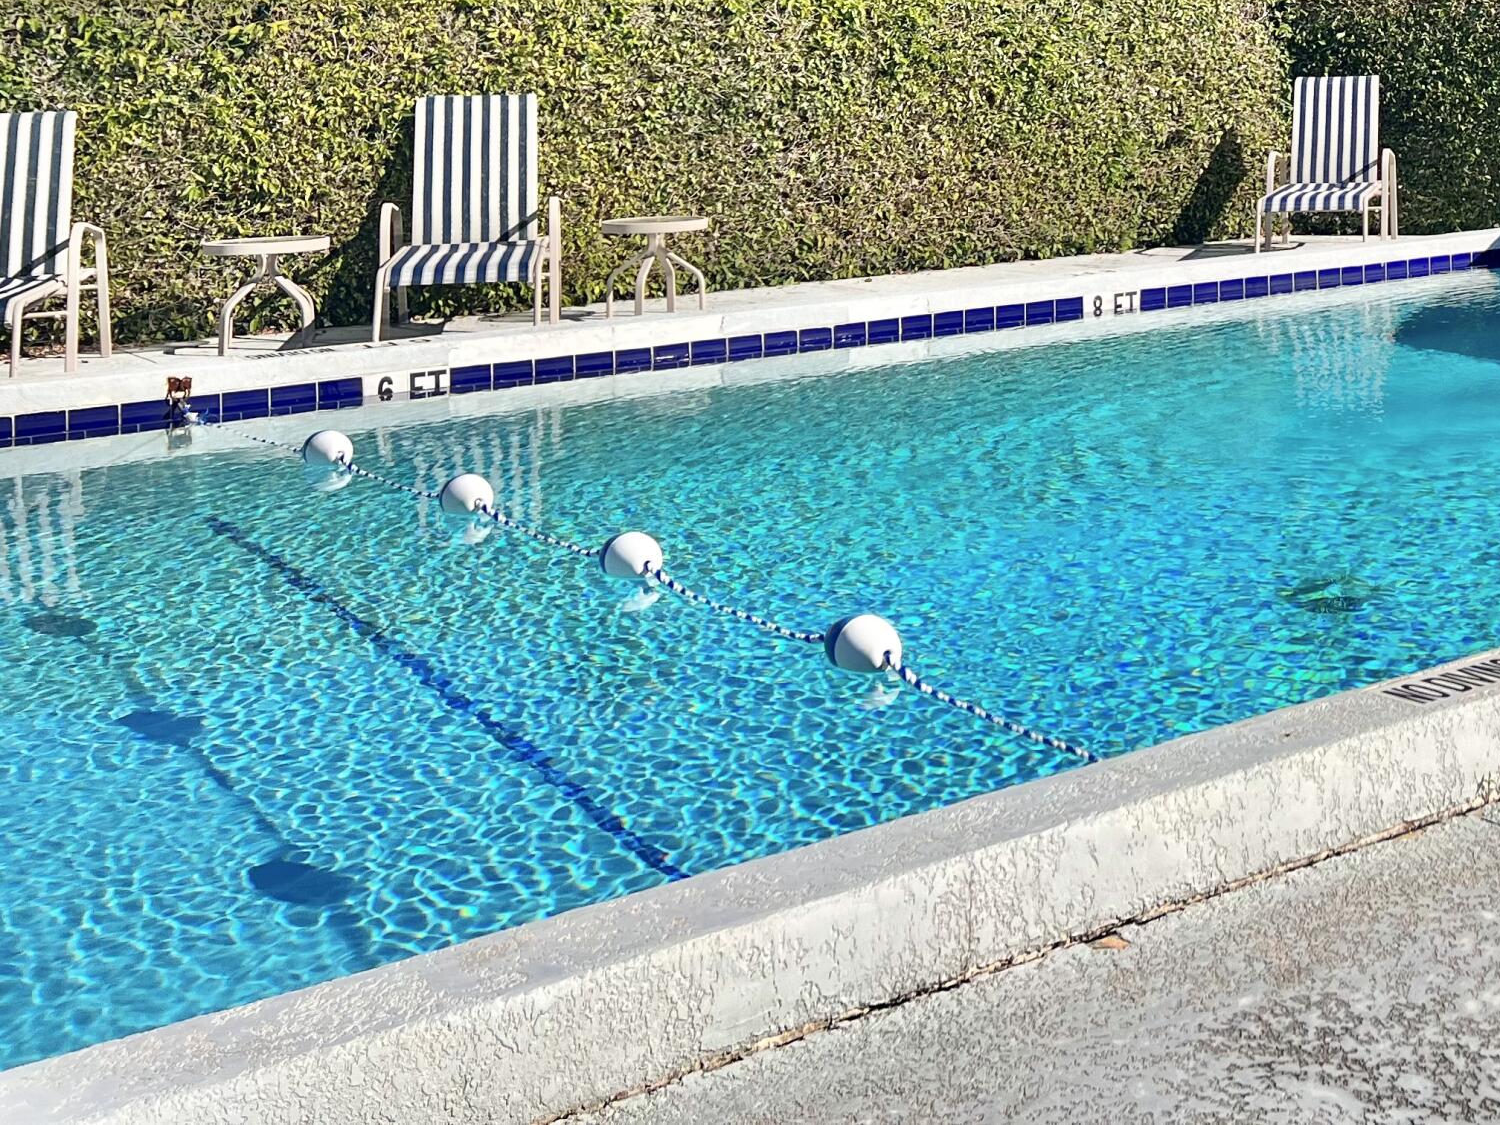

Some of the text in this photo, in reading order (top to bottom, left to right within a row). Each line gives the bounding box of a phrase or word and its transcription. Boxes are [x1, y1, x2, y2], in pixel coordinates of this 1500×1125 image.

[1093, 295, 1103, 317] 8
[378, 376, 393, 401] 6
[1382, 684, 1451, 704] NO
